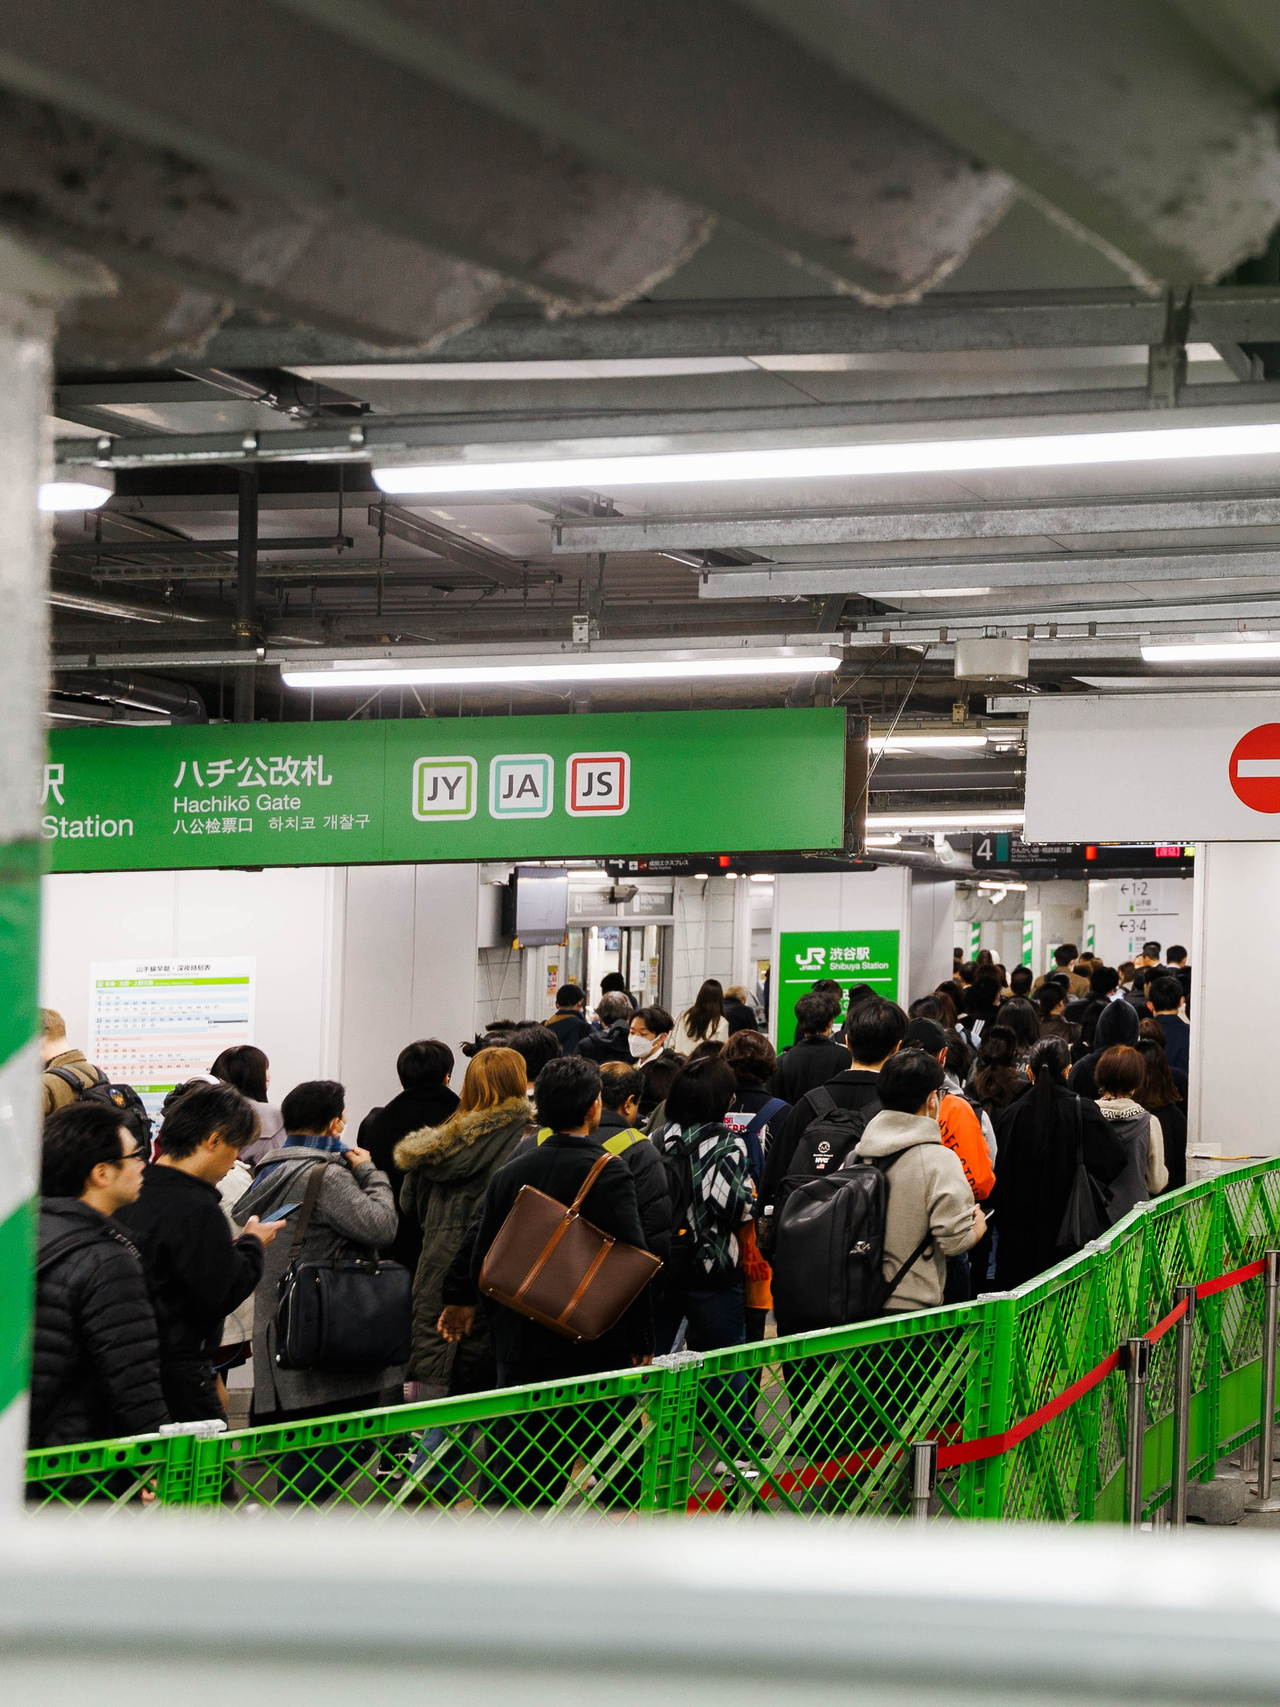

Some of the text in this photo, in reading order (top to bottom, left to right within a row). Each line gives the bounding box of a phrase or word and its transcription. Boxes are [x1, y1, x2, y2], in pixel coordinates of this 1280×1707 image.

[173, 754, 333, 788] ハチ公改札
[427, 775, 463, 801] JY
[502, 773, 540, 799] JA
[581, 771, 613, 797] JS
[173, 793, 302, 814] Hachikō Gate
[40, 814, 134, 839] Station
[172, 817, 254, 835] 八公检票口
[268, 813, 371, 832] 하치코 개찰구
[976, 838, 993, 861] 4
[795, 947, 826, 965] JR
[829, 947, 870, 961] 渋谷駅
[829, 961, 889, 971] Shibuya Station
